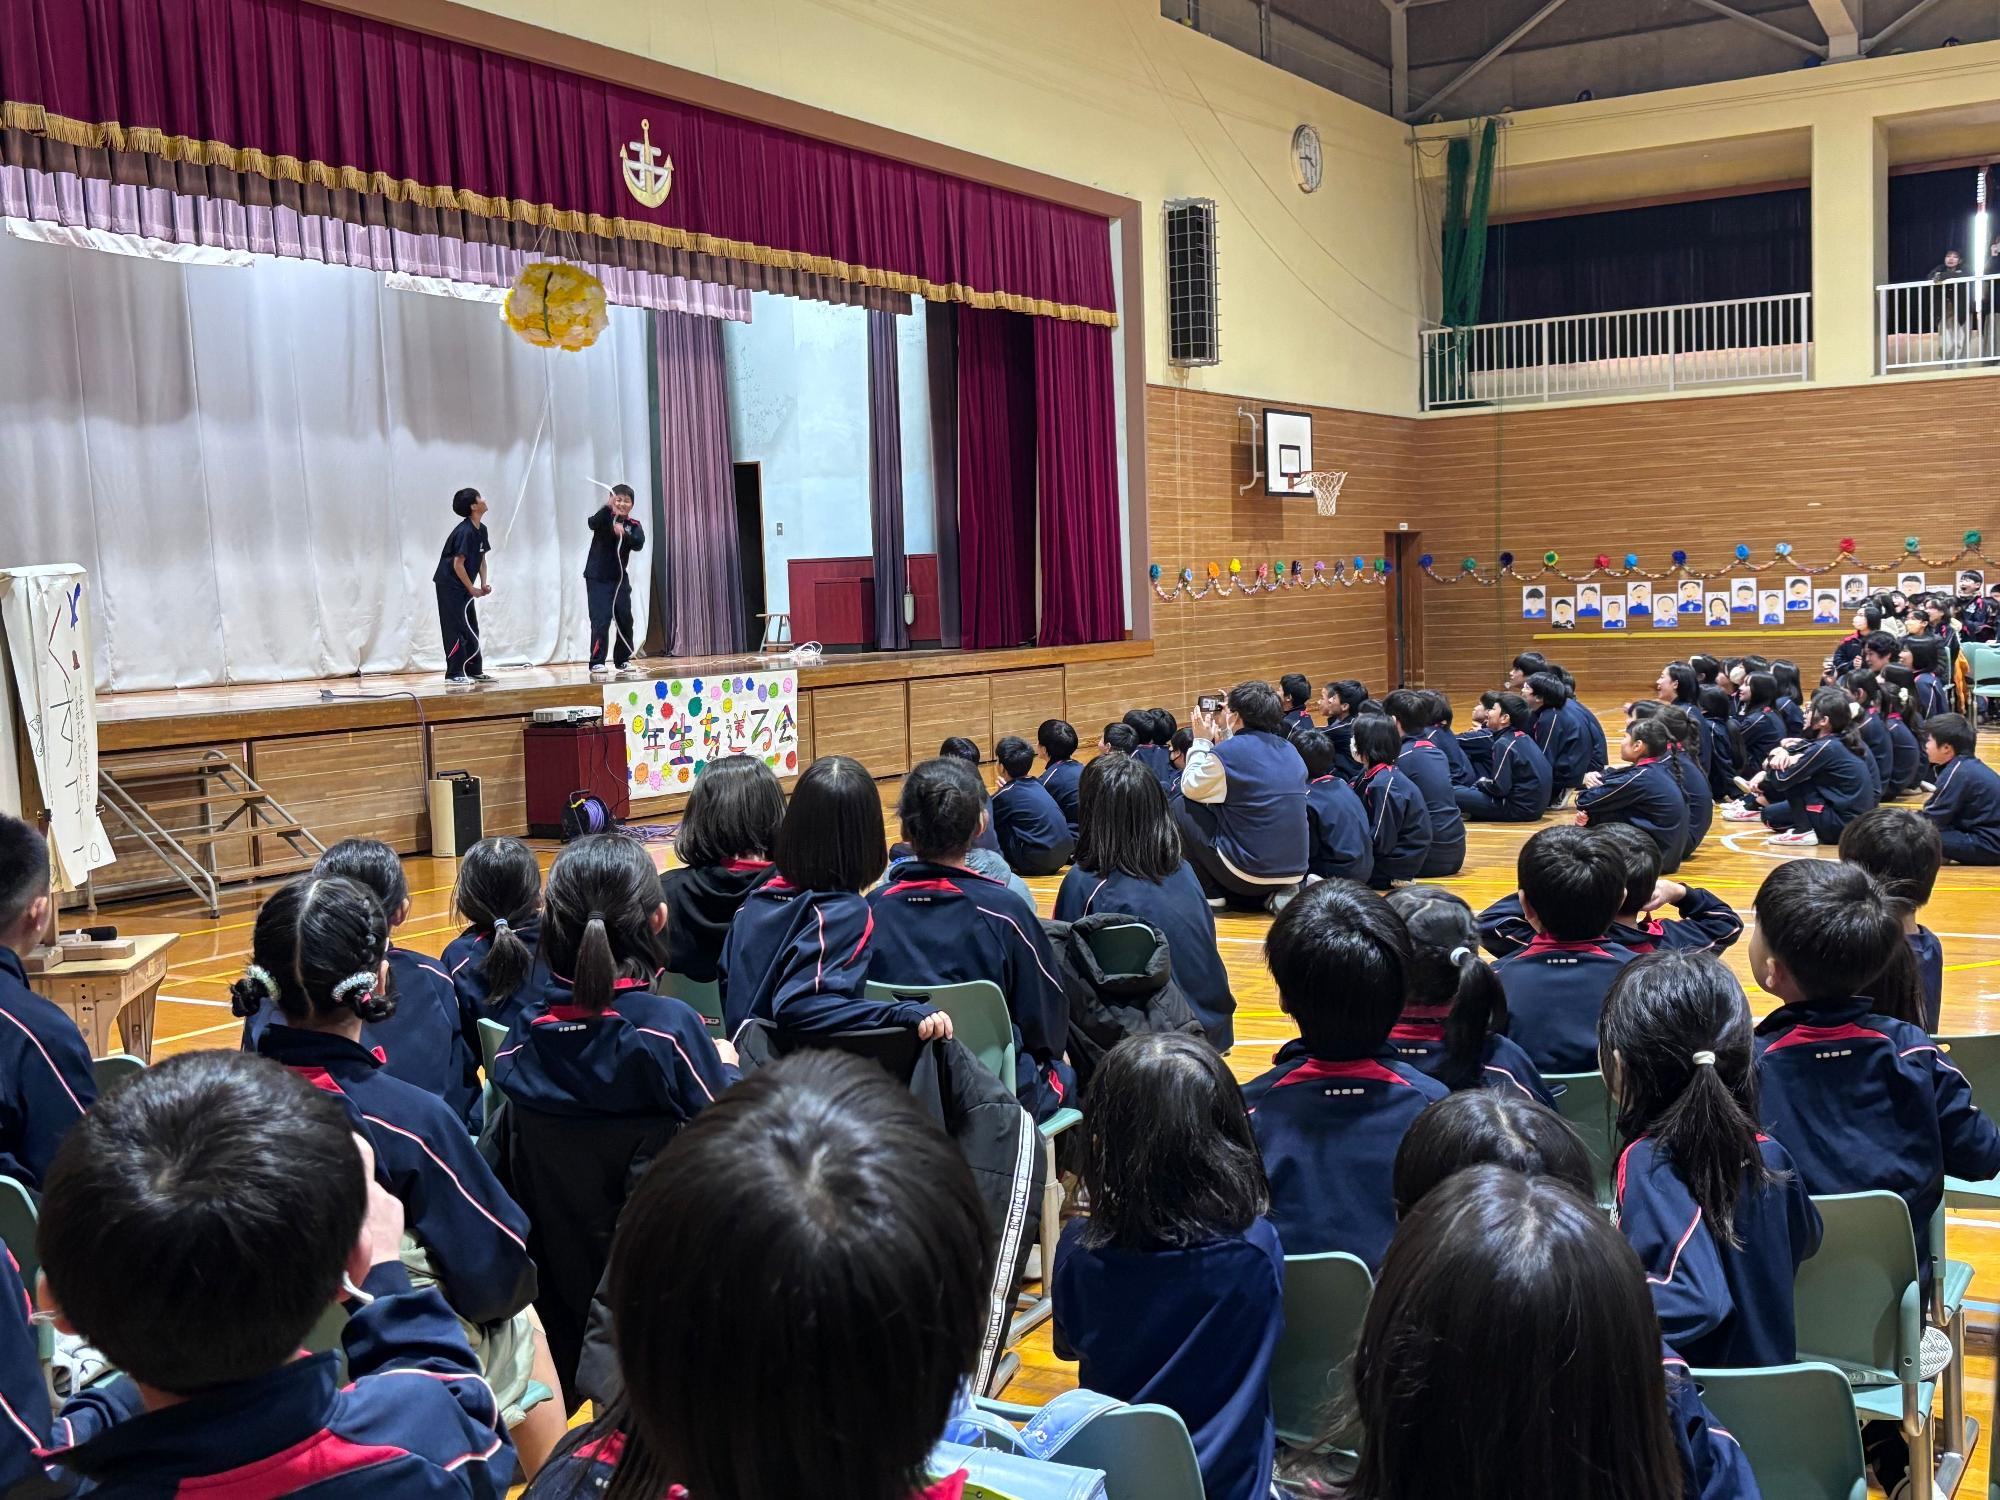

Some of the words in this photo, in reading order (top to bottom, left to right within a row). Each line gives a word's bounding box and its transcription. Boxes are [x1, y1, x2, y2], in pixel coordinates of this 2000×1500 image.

[632, 704, 797, 765] 年生を送る会
